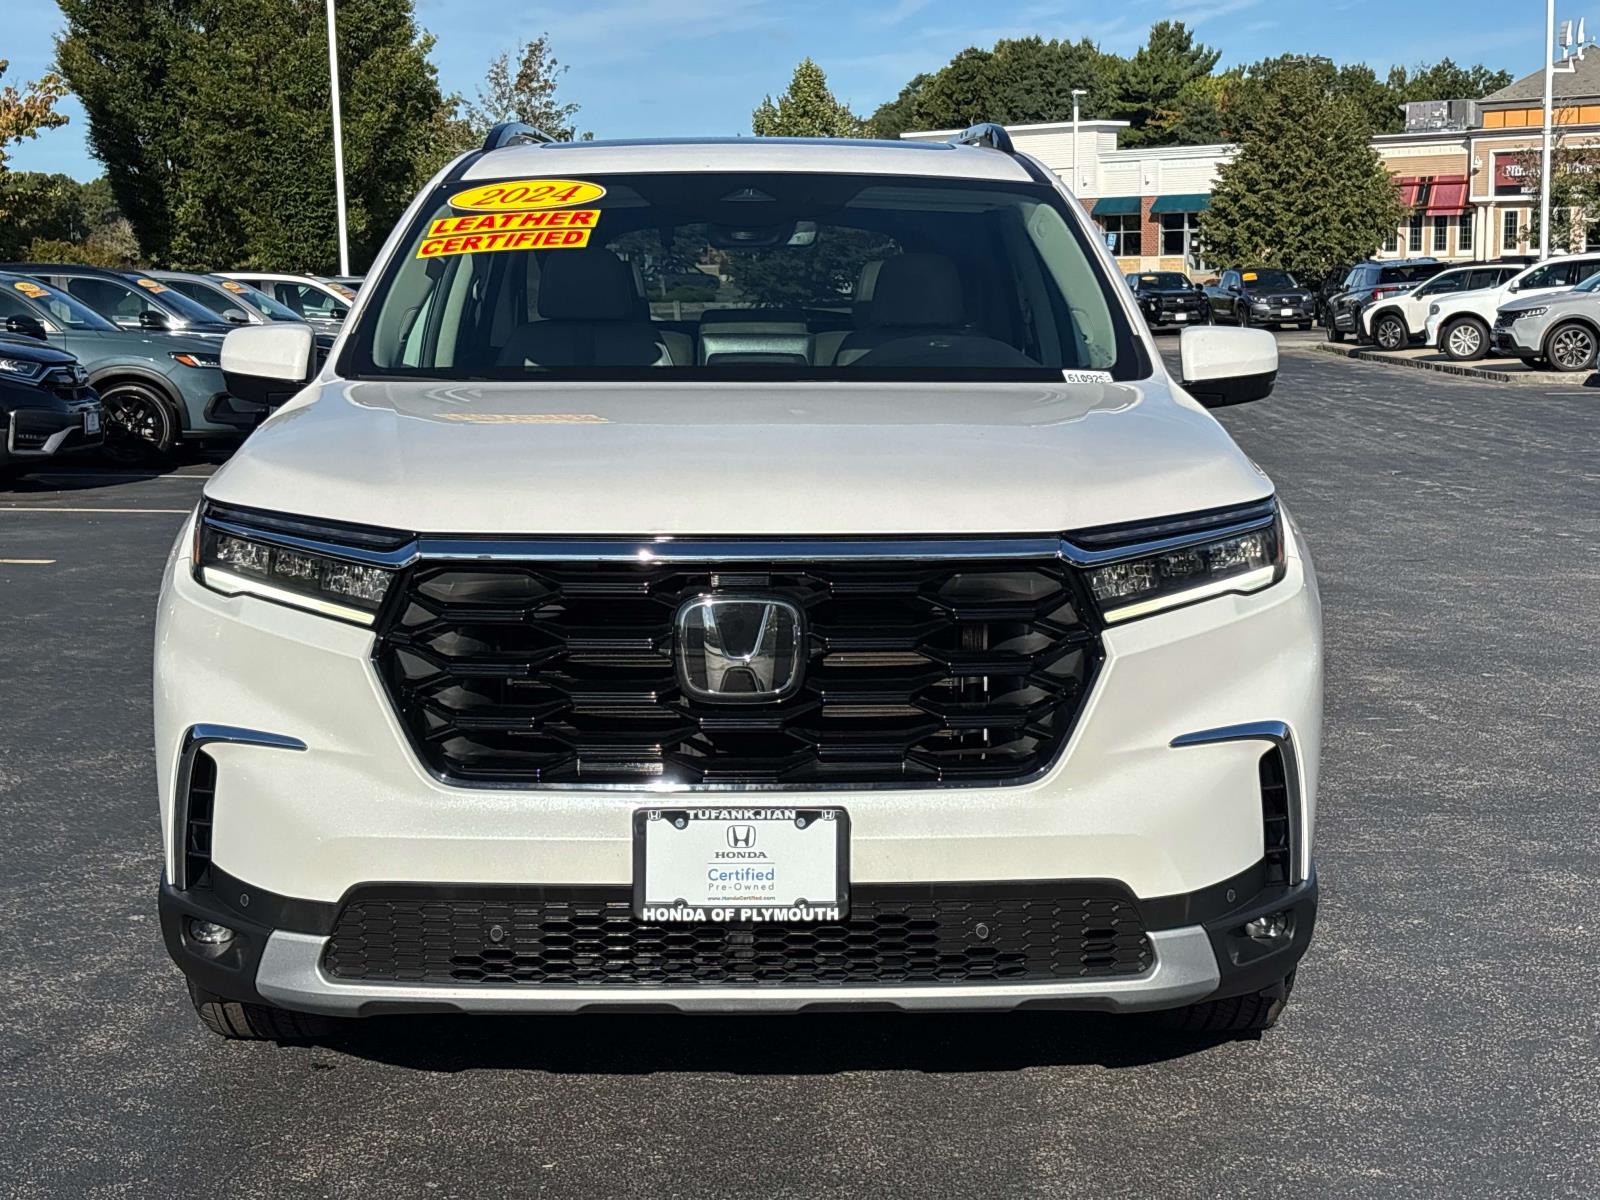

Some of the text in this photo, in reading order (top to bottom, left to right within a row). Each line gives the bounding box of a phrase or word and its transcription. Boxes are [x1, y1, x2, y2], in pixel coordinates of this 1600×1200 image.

[471, 185, 583, 206] 2024
[433, 211, 594, 234] LEATHER
[421, 230, 584, 255] CERTIFIED
[686, 809, 796, 820] TUFANKJIAN
[715, 851, 768, 859] HONDA
[708, 867, 775, 881] Certified
[708, 882, 775, 891] Pre-Owned
[642, 907, 839, 922] HONDA OF PLYMOUTH
